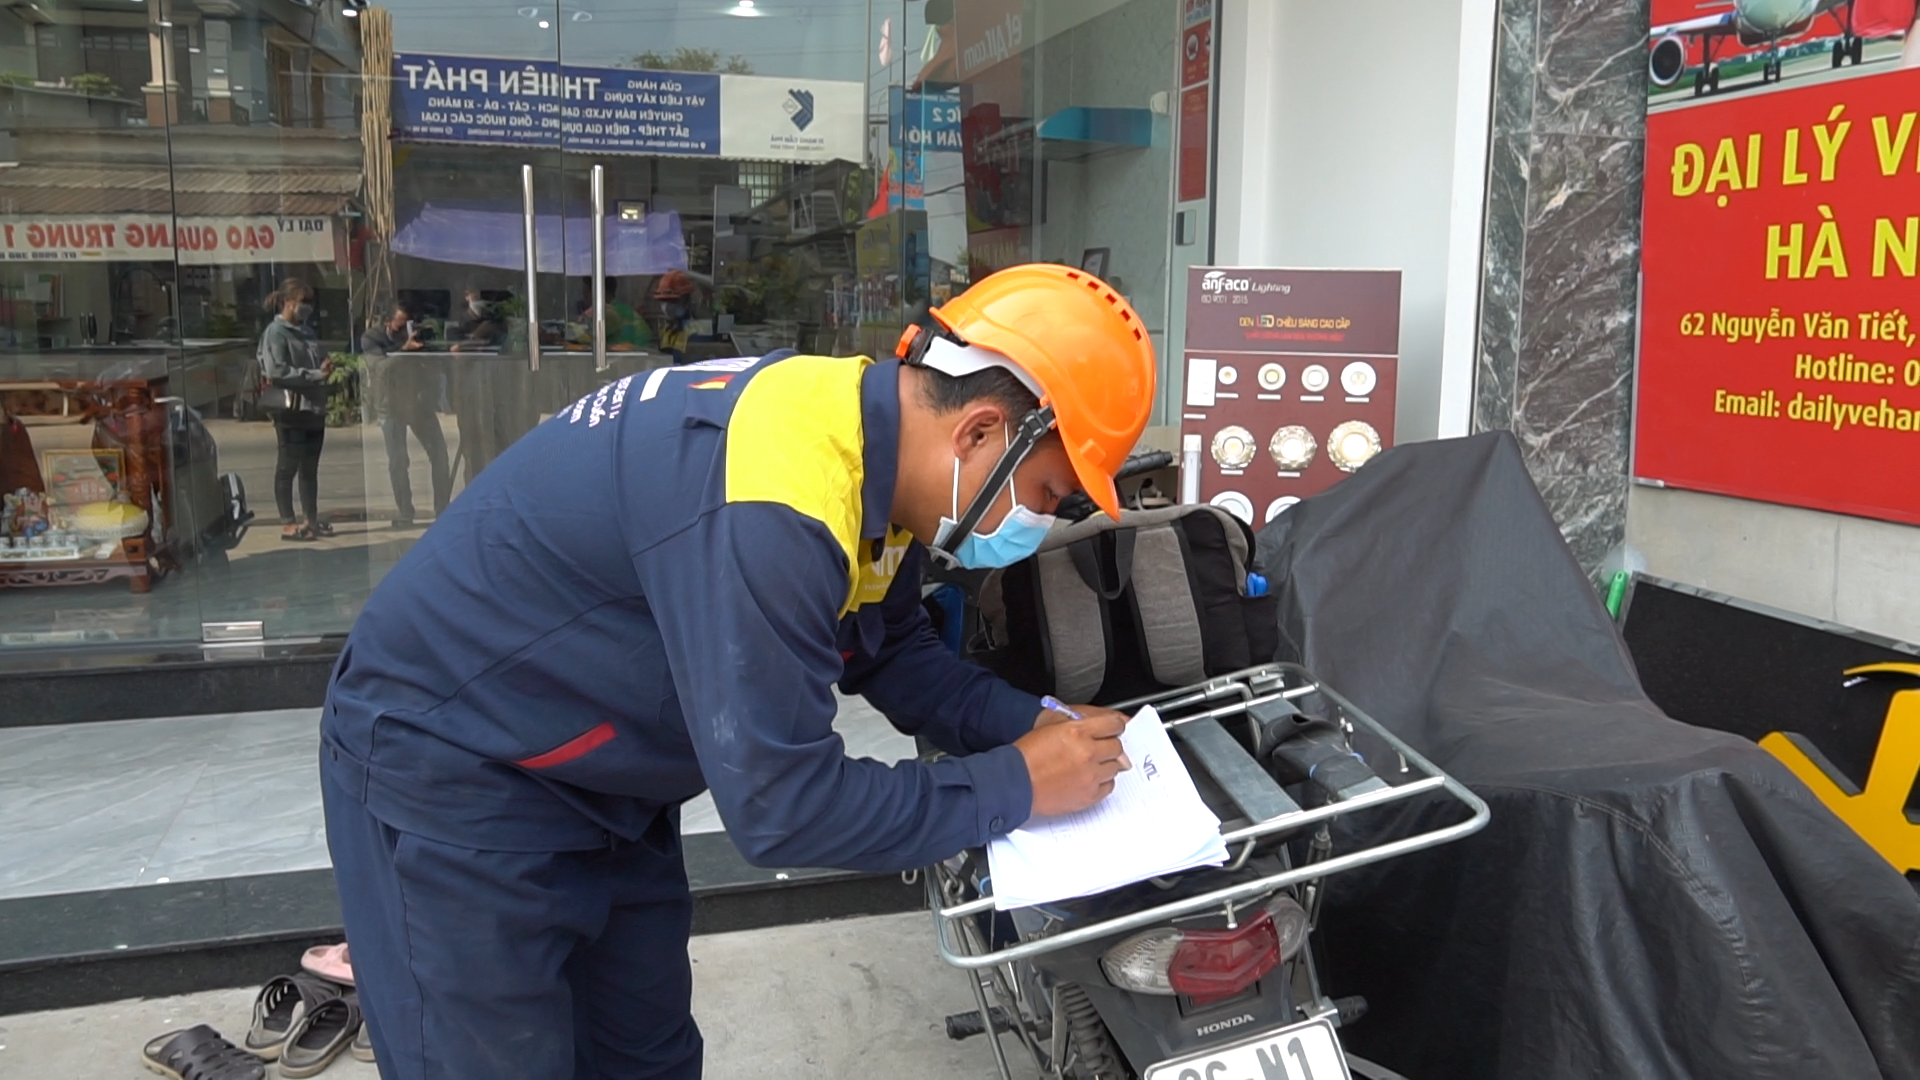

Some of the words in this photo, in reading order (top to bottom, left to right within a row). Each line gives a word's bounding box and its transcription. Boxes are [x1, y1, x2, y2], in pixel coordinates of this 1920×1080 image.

[1671, 133, 1762, 207] ĐẠI
[1782, 104, 1852, 185] LÝ
[1871, 112, 1920, 176] V
[1765, 205, 1849, 279] HÀ
[1872, 217, 1920, 277] N
[1202, 275, 1249, 294] anfaco
[1251, 282, 1291, 294] Lighting
[1680, 313, 1705, 336] 62
[1711, 307, 1795, 344] Nguyễn
[1803, 311, 1849, 339] Văn
[1858, 309, 1916, 347] Tiết,
[1795, 352, 1895, 385] Hotline:
[1904, 359, 1920, 387] 0
[1714, 389, 1780, 418] Email:
[1196, 1013, 1256, 1037] HONDA
